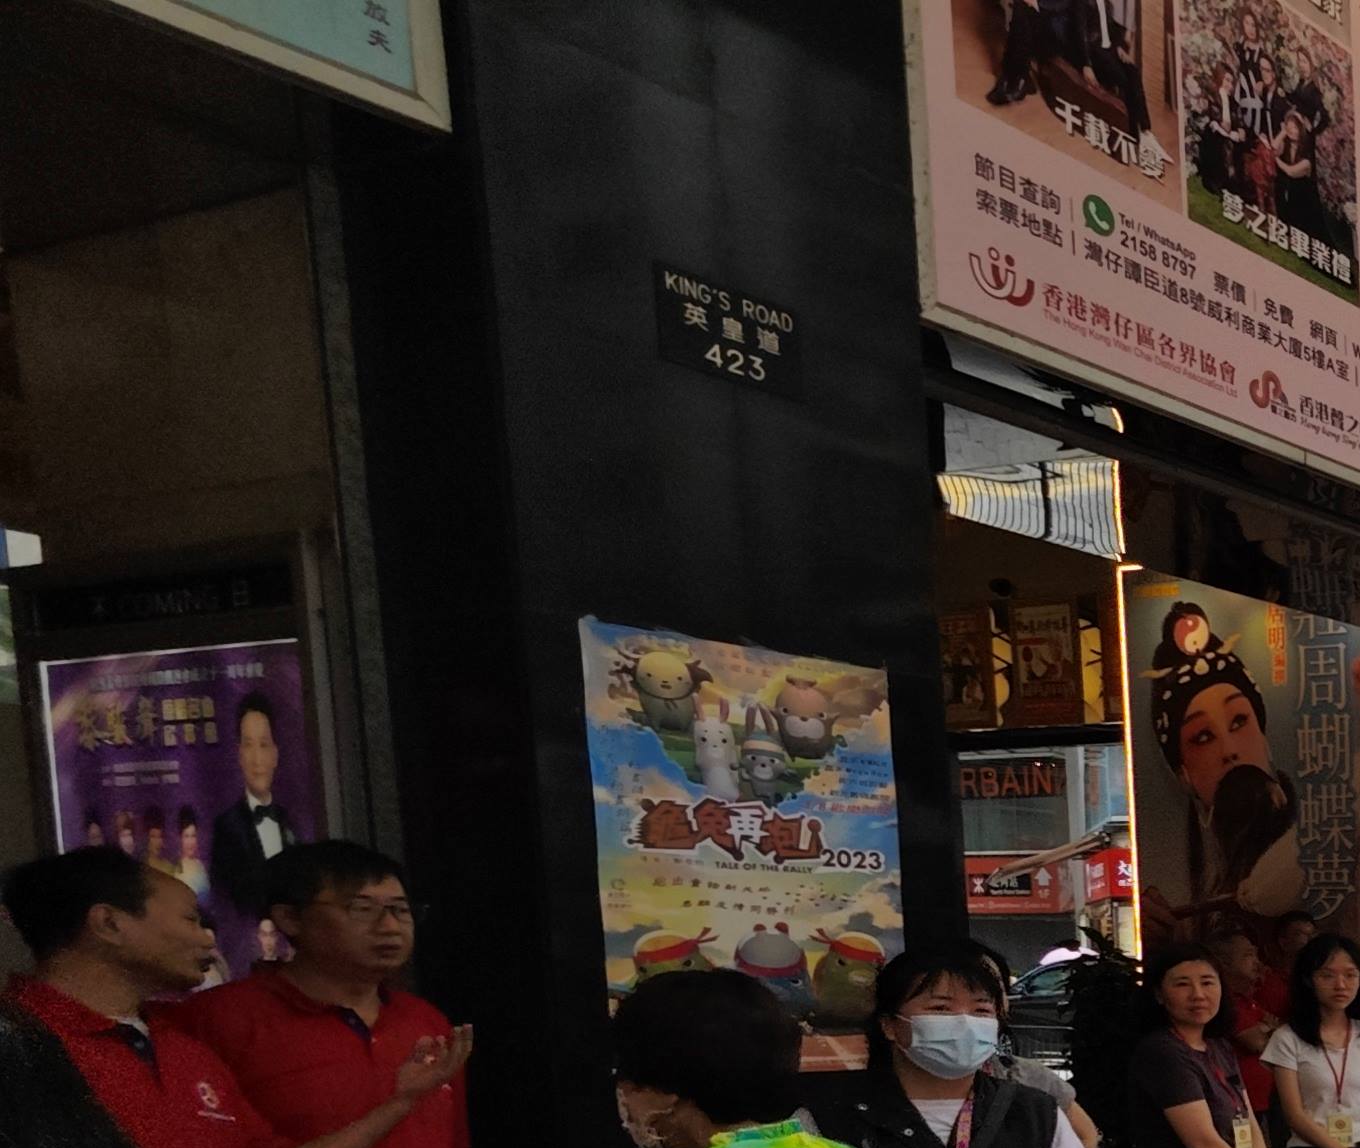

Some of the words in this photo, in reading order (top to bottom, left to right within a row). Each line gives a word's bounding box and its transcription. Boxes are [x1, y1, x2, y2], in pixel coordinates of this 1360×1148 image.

[1055, 97, 1175, 185] 千載不變
[974, 153, 1061, 217] 節目查詢
[975, 189, 1063, 249] 索票地點
[1119, 212, 1134, 230] Tel
[1143, 225, 1197, 262] WhatsApp
[1221, 189, 1352, 286] 夢之路畢業禮
[1120, 231, 1158, 263] 2158
[1162, 250, 1197, 281] 8797
[664, 271, 732, 312] KING'S
[741, 299, 794, 334] ROAD
[683, 302, 782, 356] 英皇道
[1213, 271, 1247, 305] 票價
[1264, 297, 1294, 330] 免費
[1310, 320, 1339, 350] 網頁
[704, 344, 767, 383] 423
[1042, 283, 1237, 387] 香港灣仔區各界協會
[715, 860, 740, 871] TALE
[742, 862, 757, 872] OF
[759, 864, 780, 873] THE
[821, 849, 882, 870] 2023
